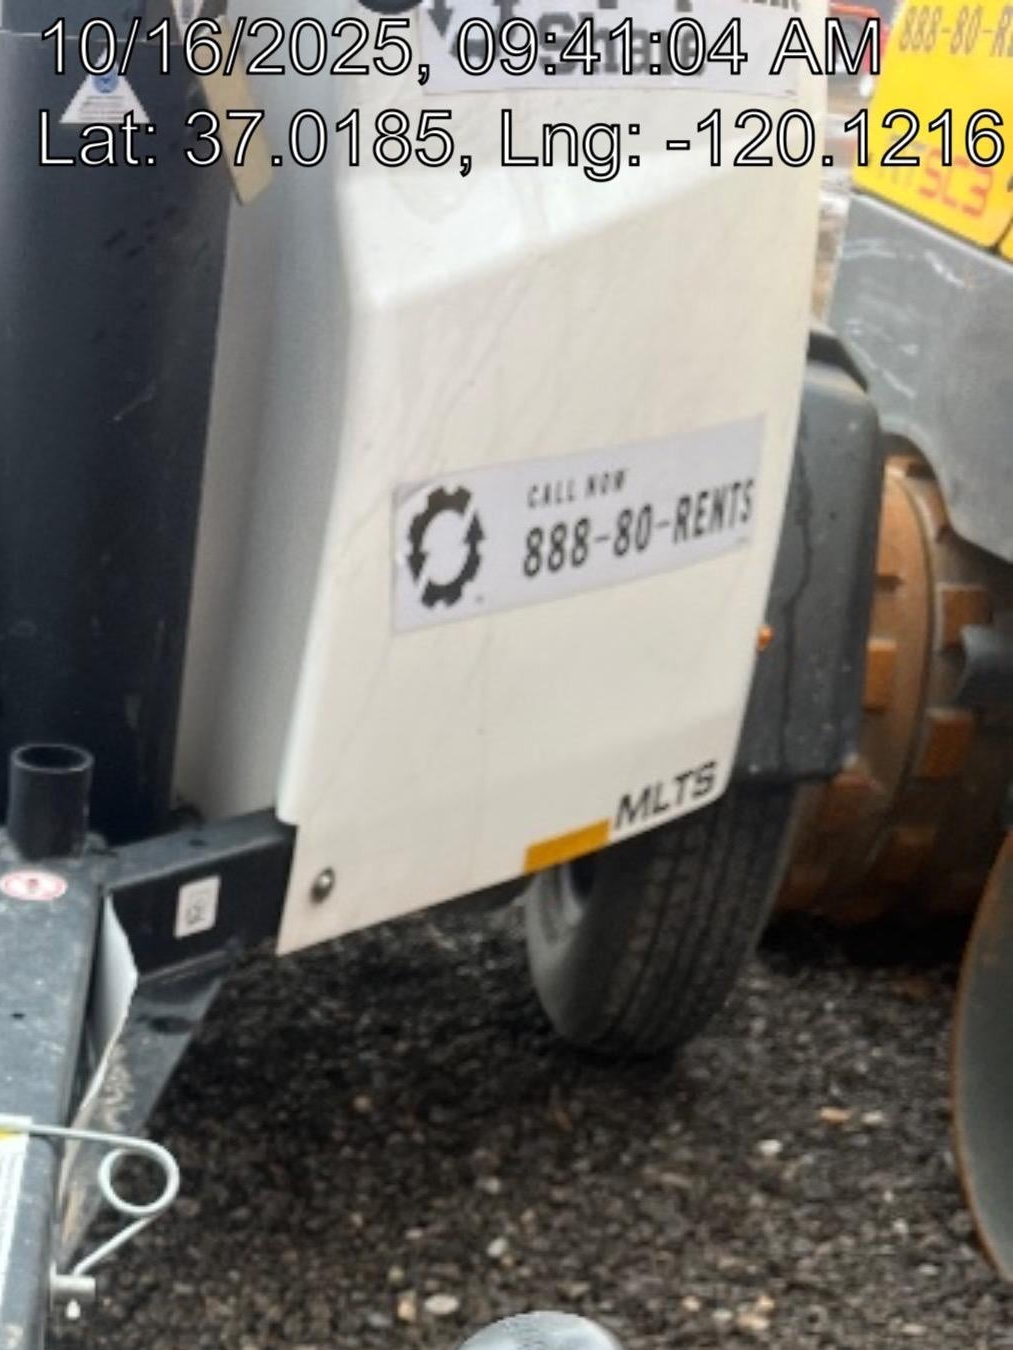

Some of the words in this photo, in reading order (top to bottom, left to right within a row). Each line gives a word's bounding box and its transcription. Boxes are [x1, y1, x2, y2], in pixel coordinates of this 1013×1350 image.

[527, 480, 576, 509] CALL
[585, 469, 627, 497] NOW
[523, 478, 754, 578] 888-80-RENTS
[614, 760, 717, 830] MLTS
